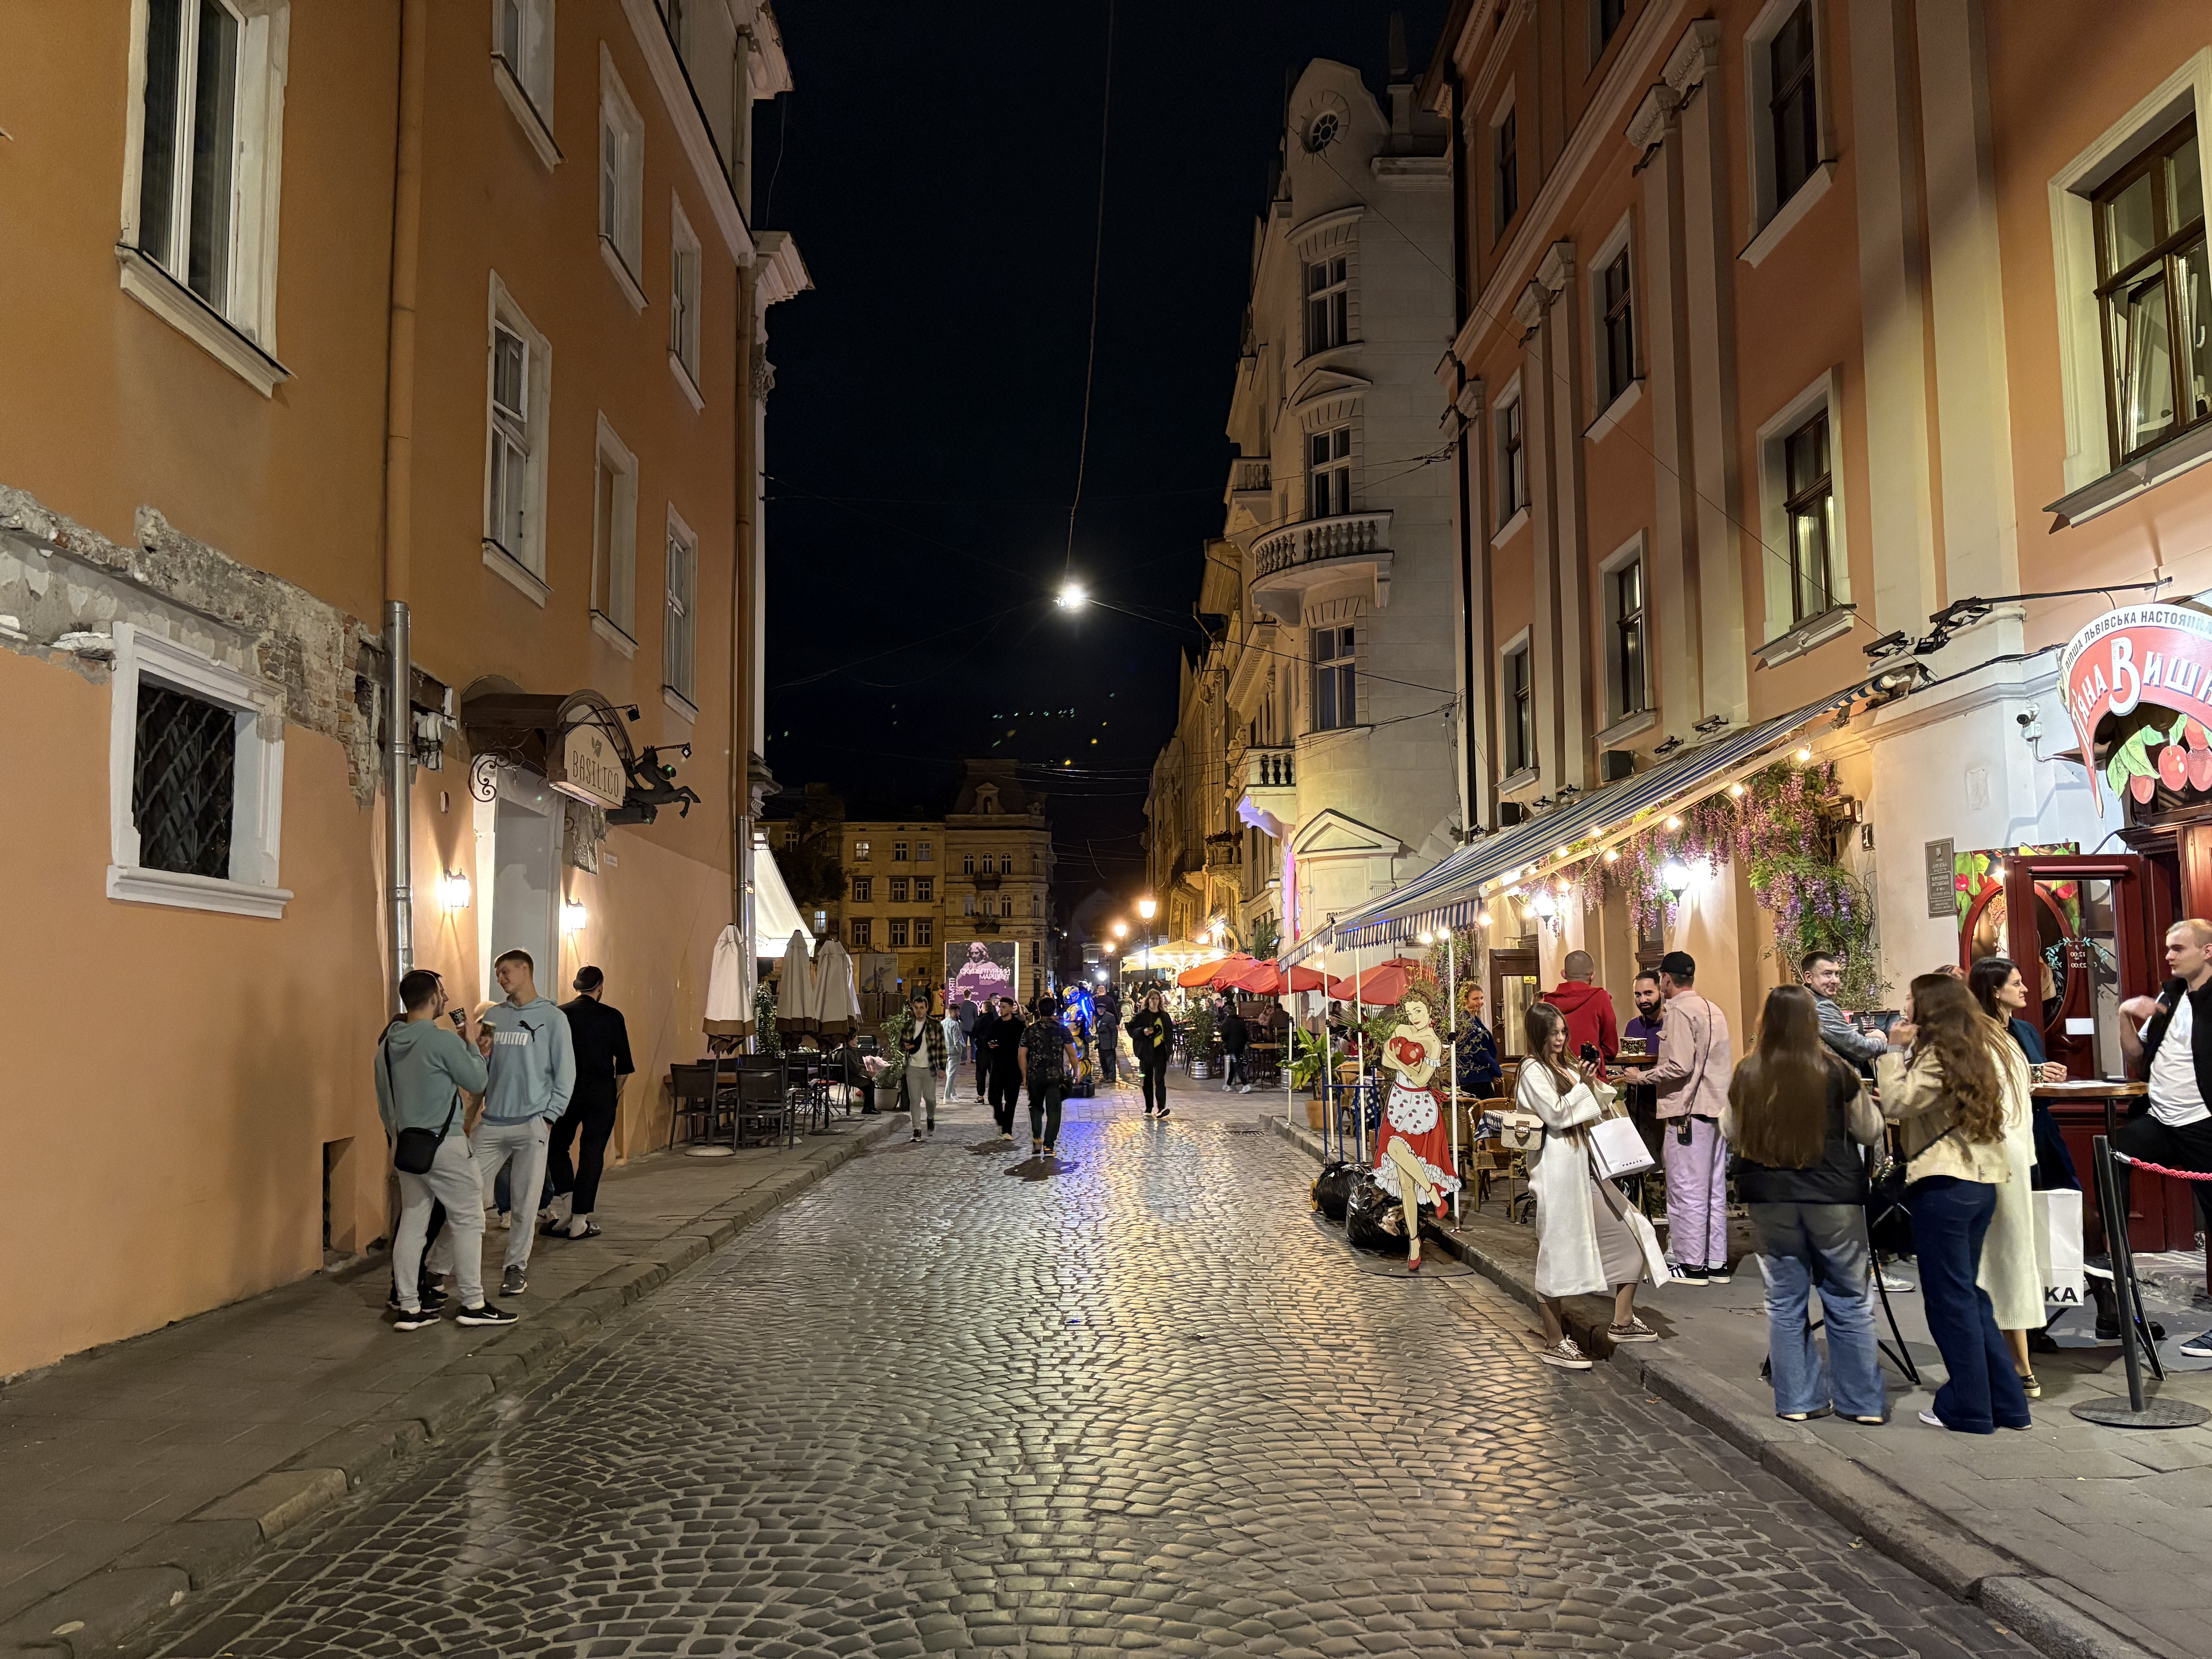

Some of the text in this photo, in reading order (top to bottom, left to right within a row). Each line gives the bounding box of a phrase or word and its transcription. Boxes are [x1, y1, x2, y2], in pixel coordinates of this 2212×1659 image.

[2065, 639, 2083, 672] ЛІПША
[2084, 612, 2136, 644] ЛЬВІВСЬКА
[573, 750, 619, 797] BASILICO
[493, 1032, 529, 1046] PUMA
